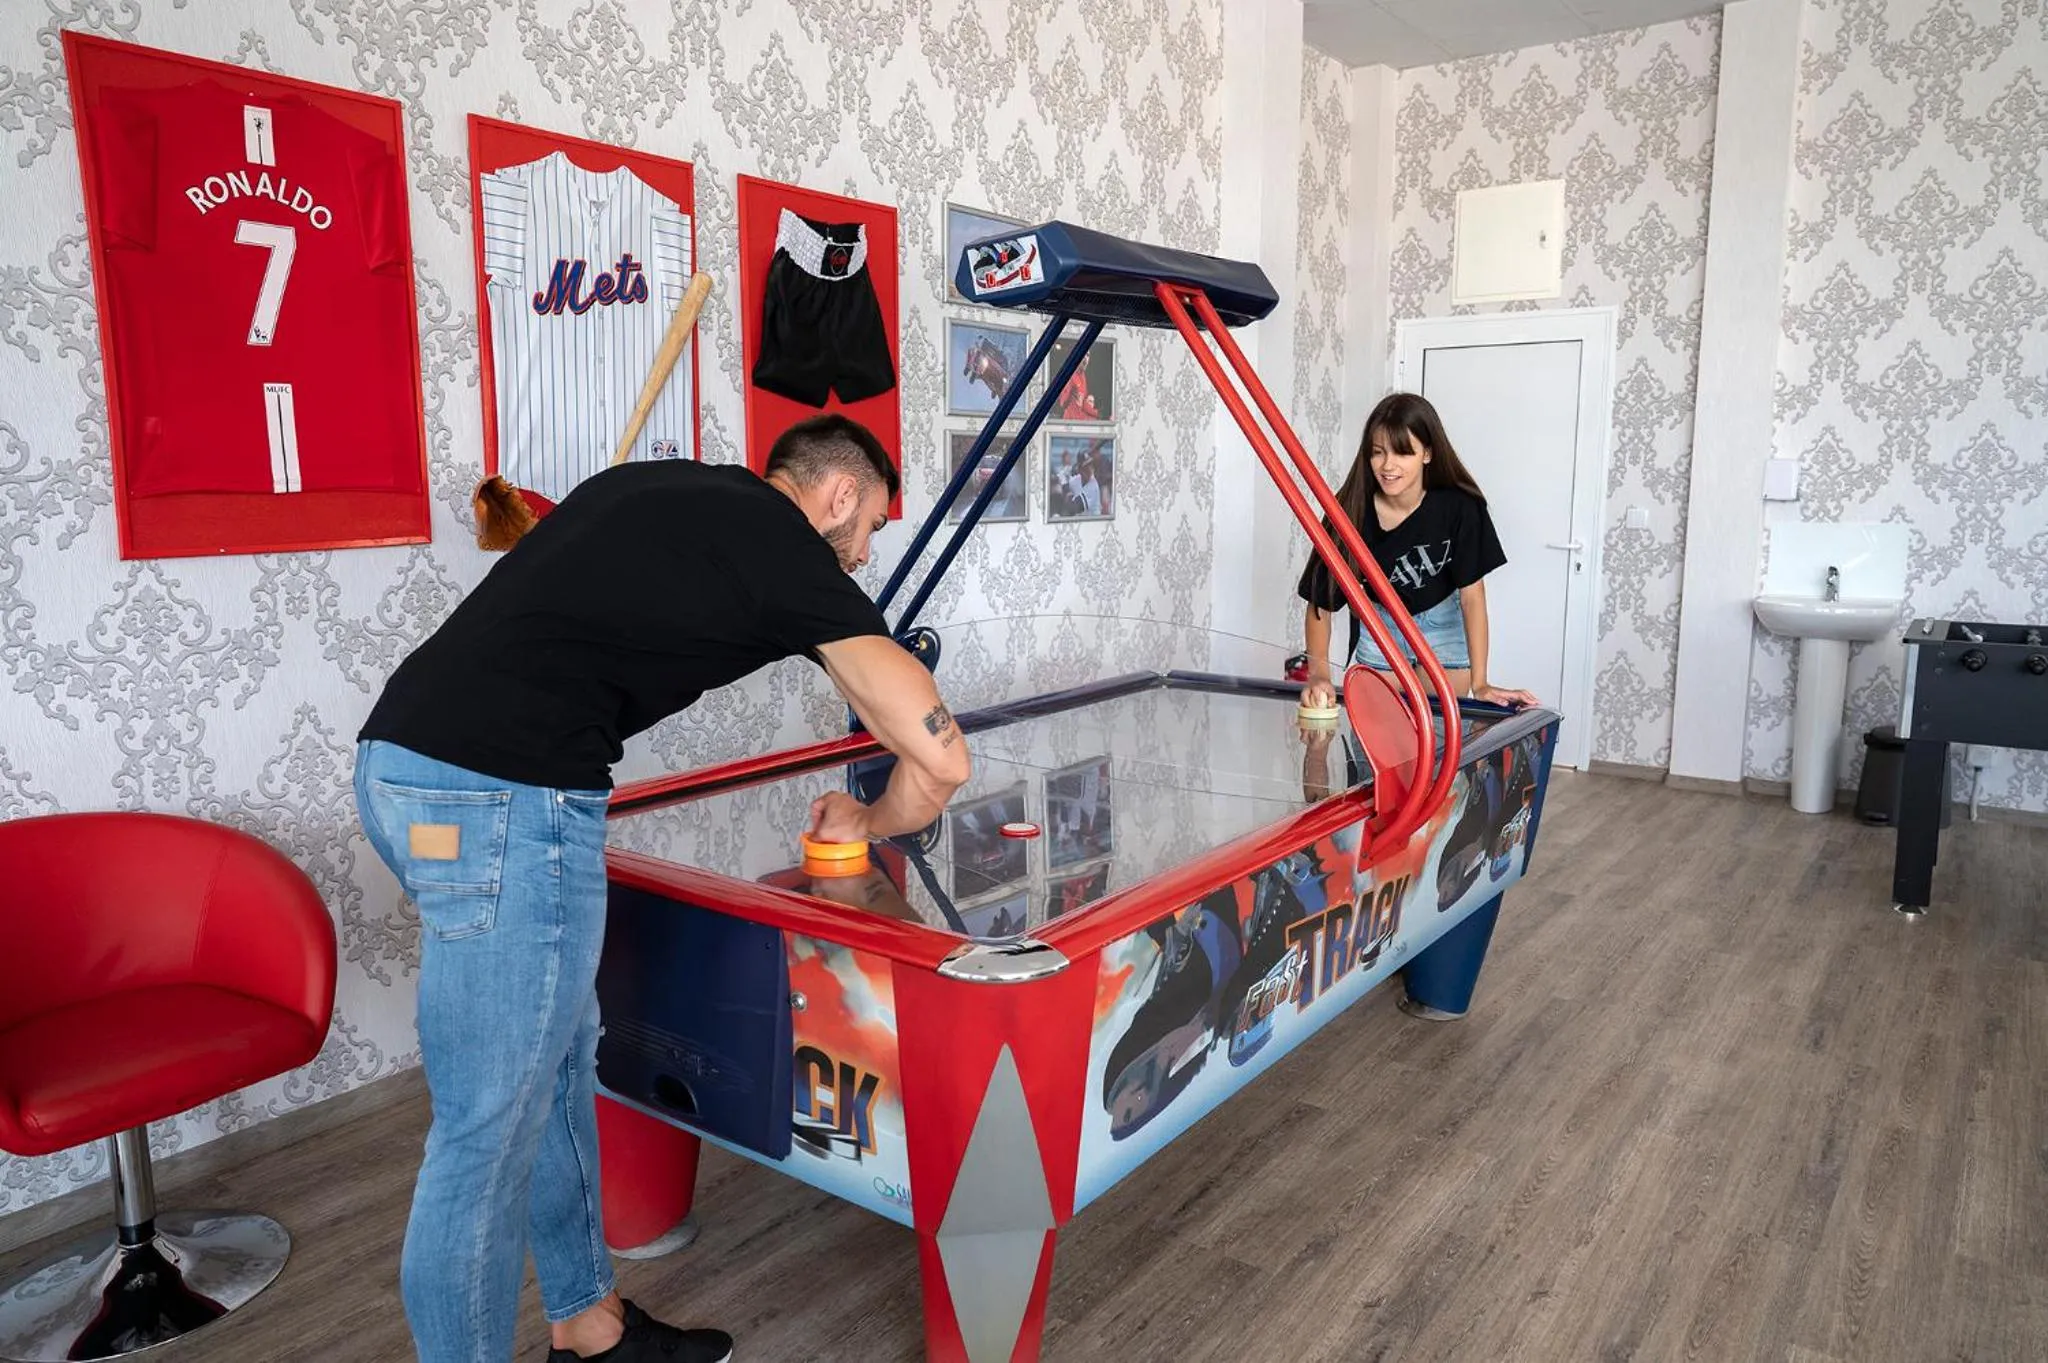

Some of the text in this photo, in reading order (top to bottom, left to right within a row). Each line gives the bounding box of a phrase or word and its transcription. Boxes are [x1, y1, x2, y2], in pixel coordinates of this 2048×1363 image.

[185, 170, 333, 231] RONALDO
[234, 219, 297, 346] 7
[532, 252, 648, 316] Mets
[1285, 872, 1412, 1015] TRACK
